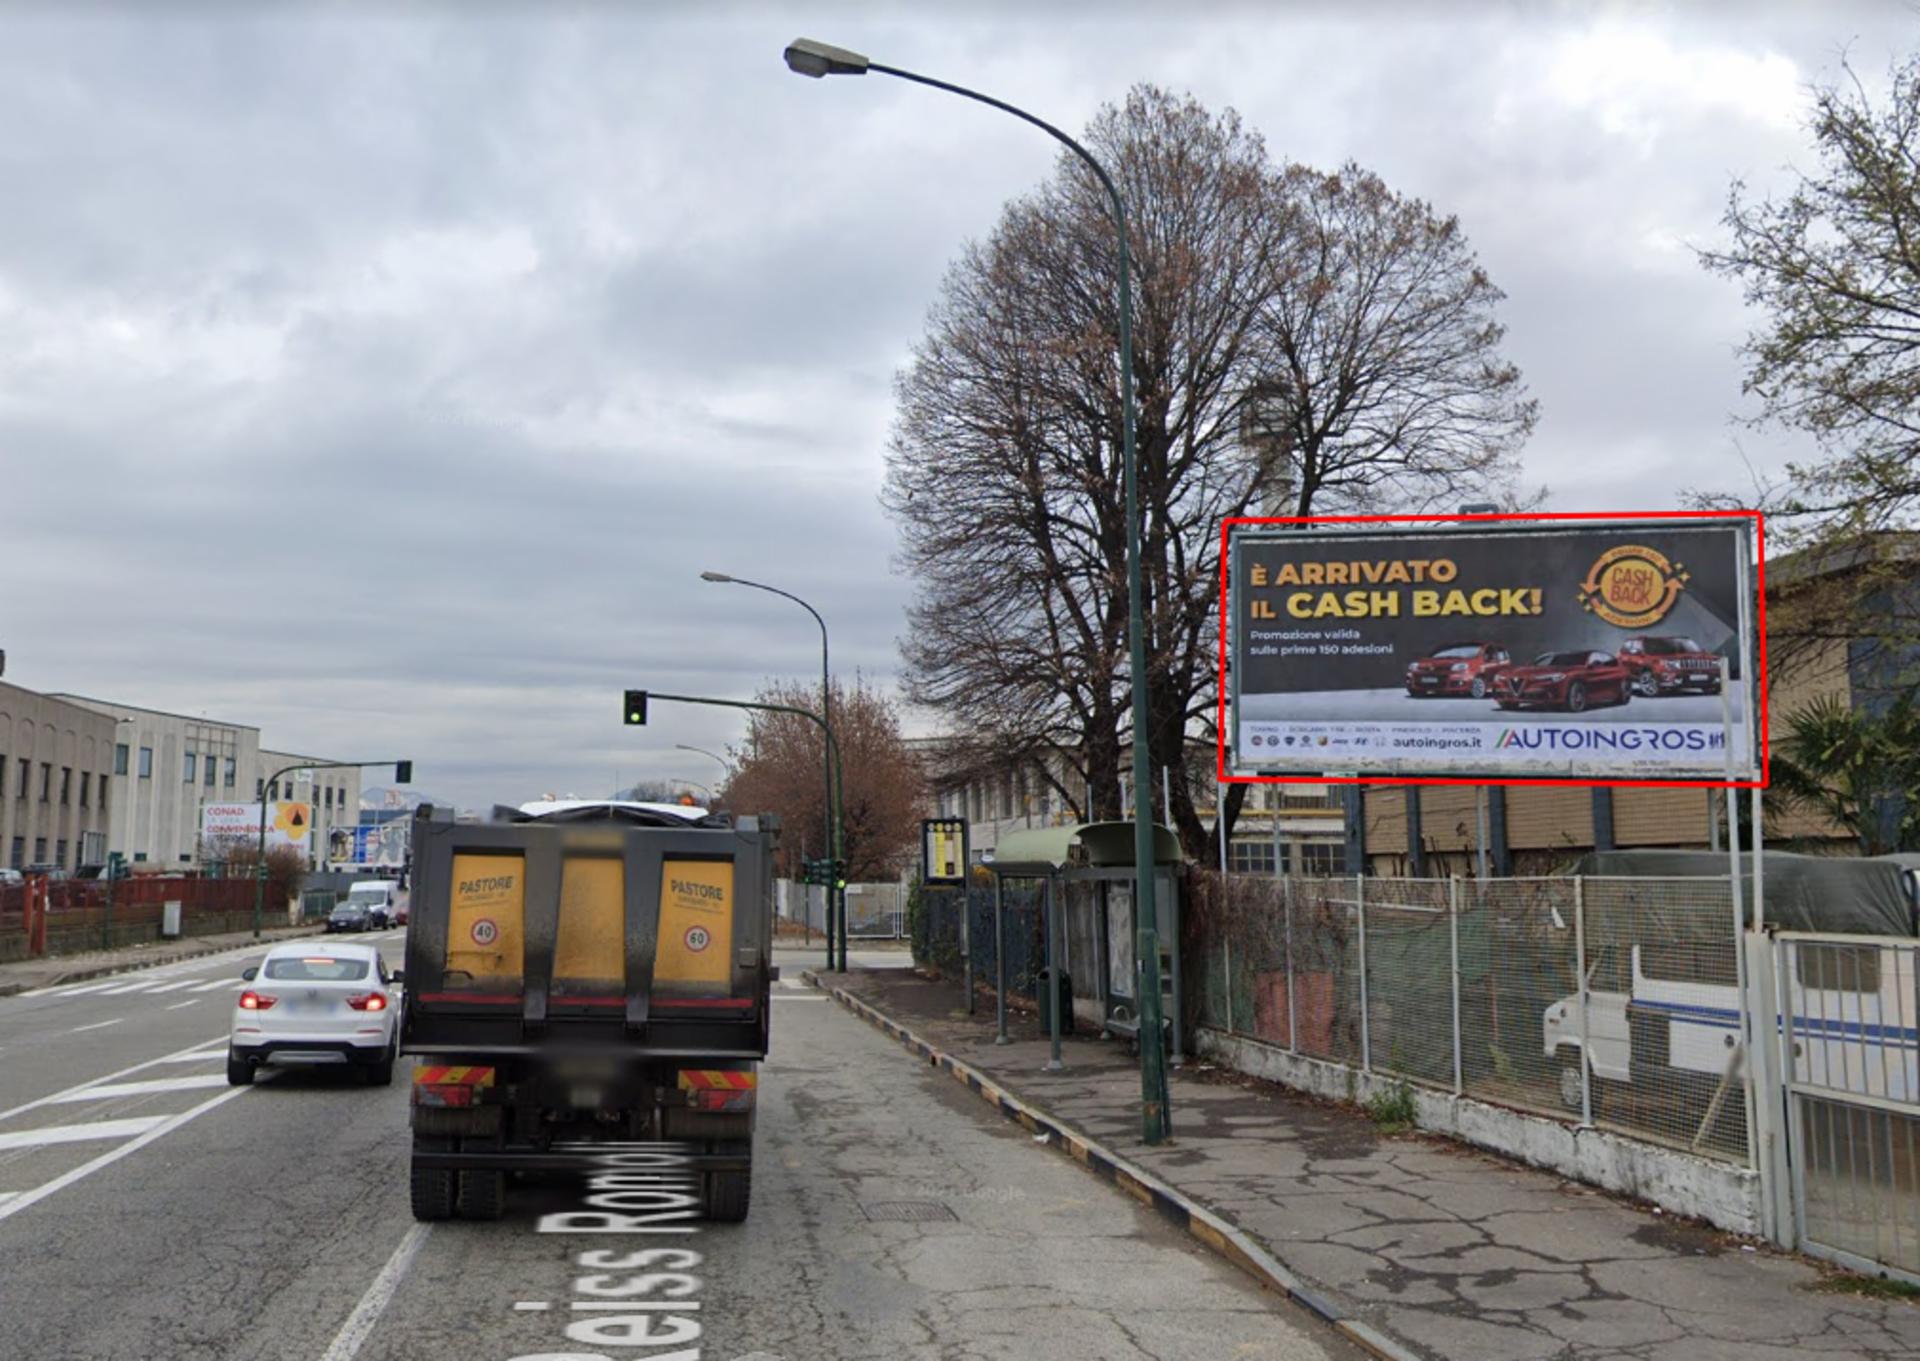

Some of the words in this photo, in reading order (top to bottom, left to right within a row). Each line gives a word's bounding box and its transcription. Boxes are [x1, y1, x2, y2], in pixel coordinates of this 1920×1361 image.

[1250, 562, 1267, 586] È
[1276, 559, 1458, 585] ARRIVATO
[1612, 567, 1655, 587] CASH
[1250, 600, 1276, 619] IL
[1287, 591, 1399, 618] CASH
[1412, 588, 1544, 616] BACK!
[1610, 585, 1652, 605] BACK
[1250, 629, 1321, 640] Promozione
[1324, 629, 1361, 640] valida
[1250, 645, 1279, 656] sulle
[1280, 645, 1317, 657] prime
[1319, 644, 1340, 655] 150
[1341, 643, 1394, 656] adesioni
[1393, 736, 1482, 749] autoingros.it
[1497, 729, 1706, 750] AUTOINGROS
[206, 823, 274, 833] CONVENIENA
[459, 876, 514, 894] PASTORE
[671, 879, 724, 902] PASTORE
[476, 925, 493, 939] 40
[689, 932, 705, 945] 60
